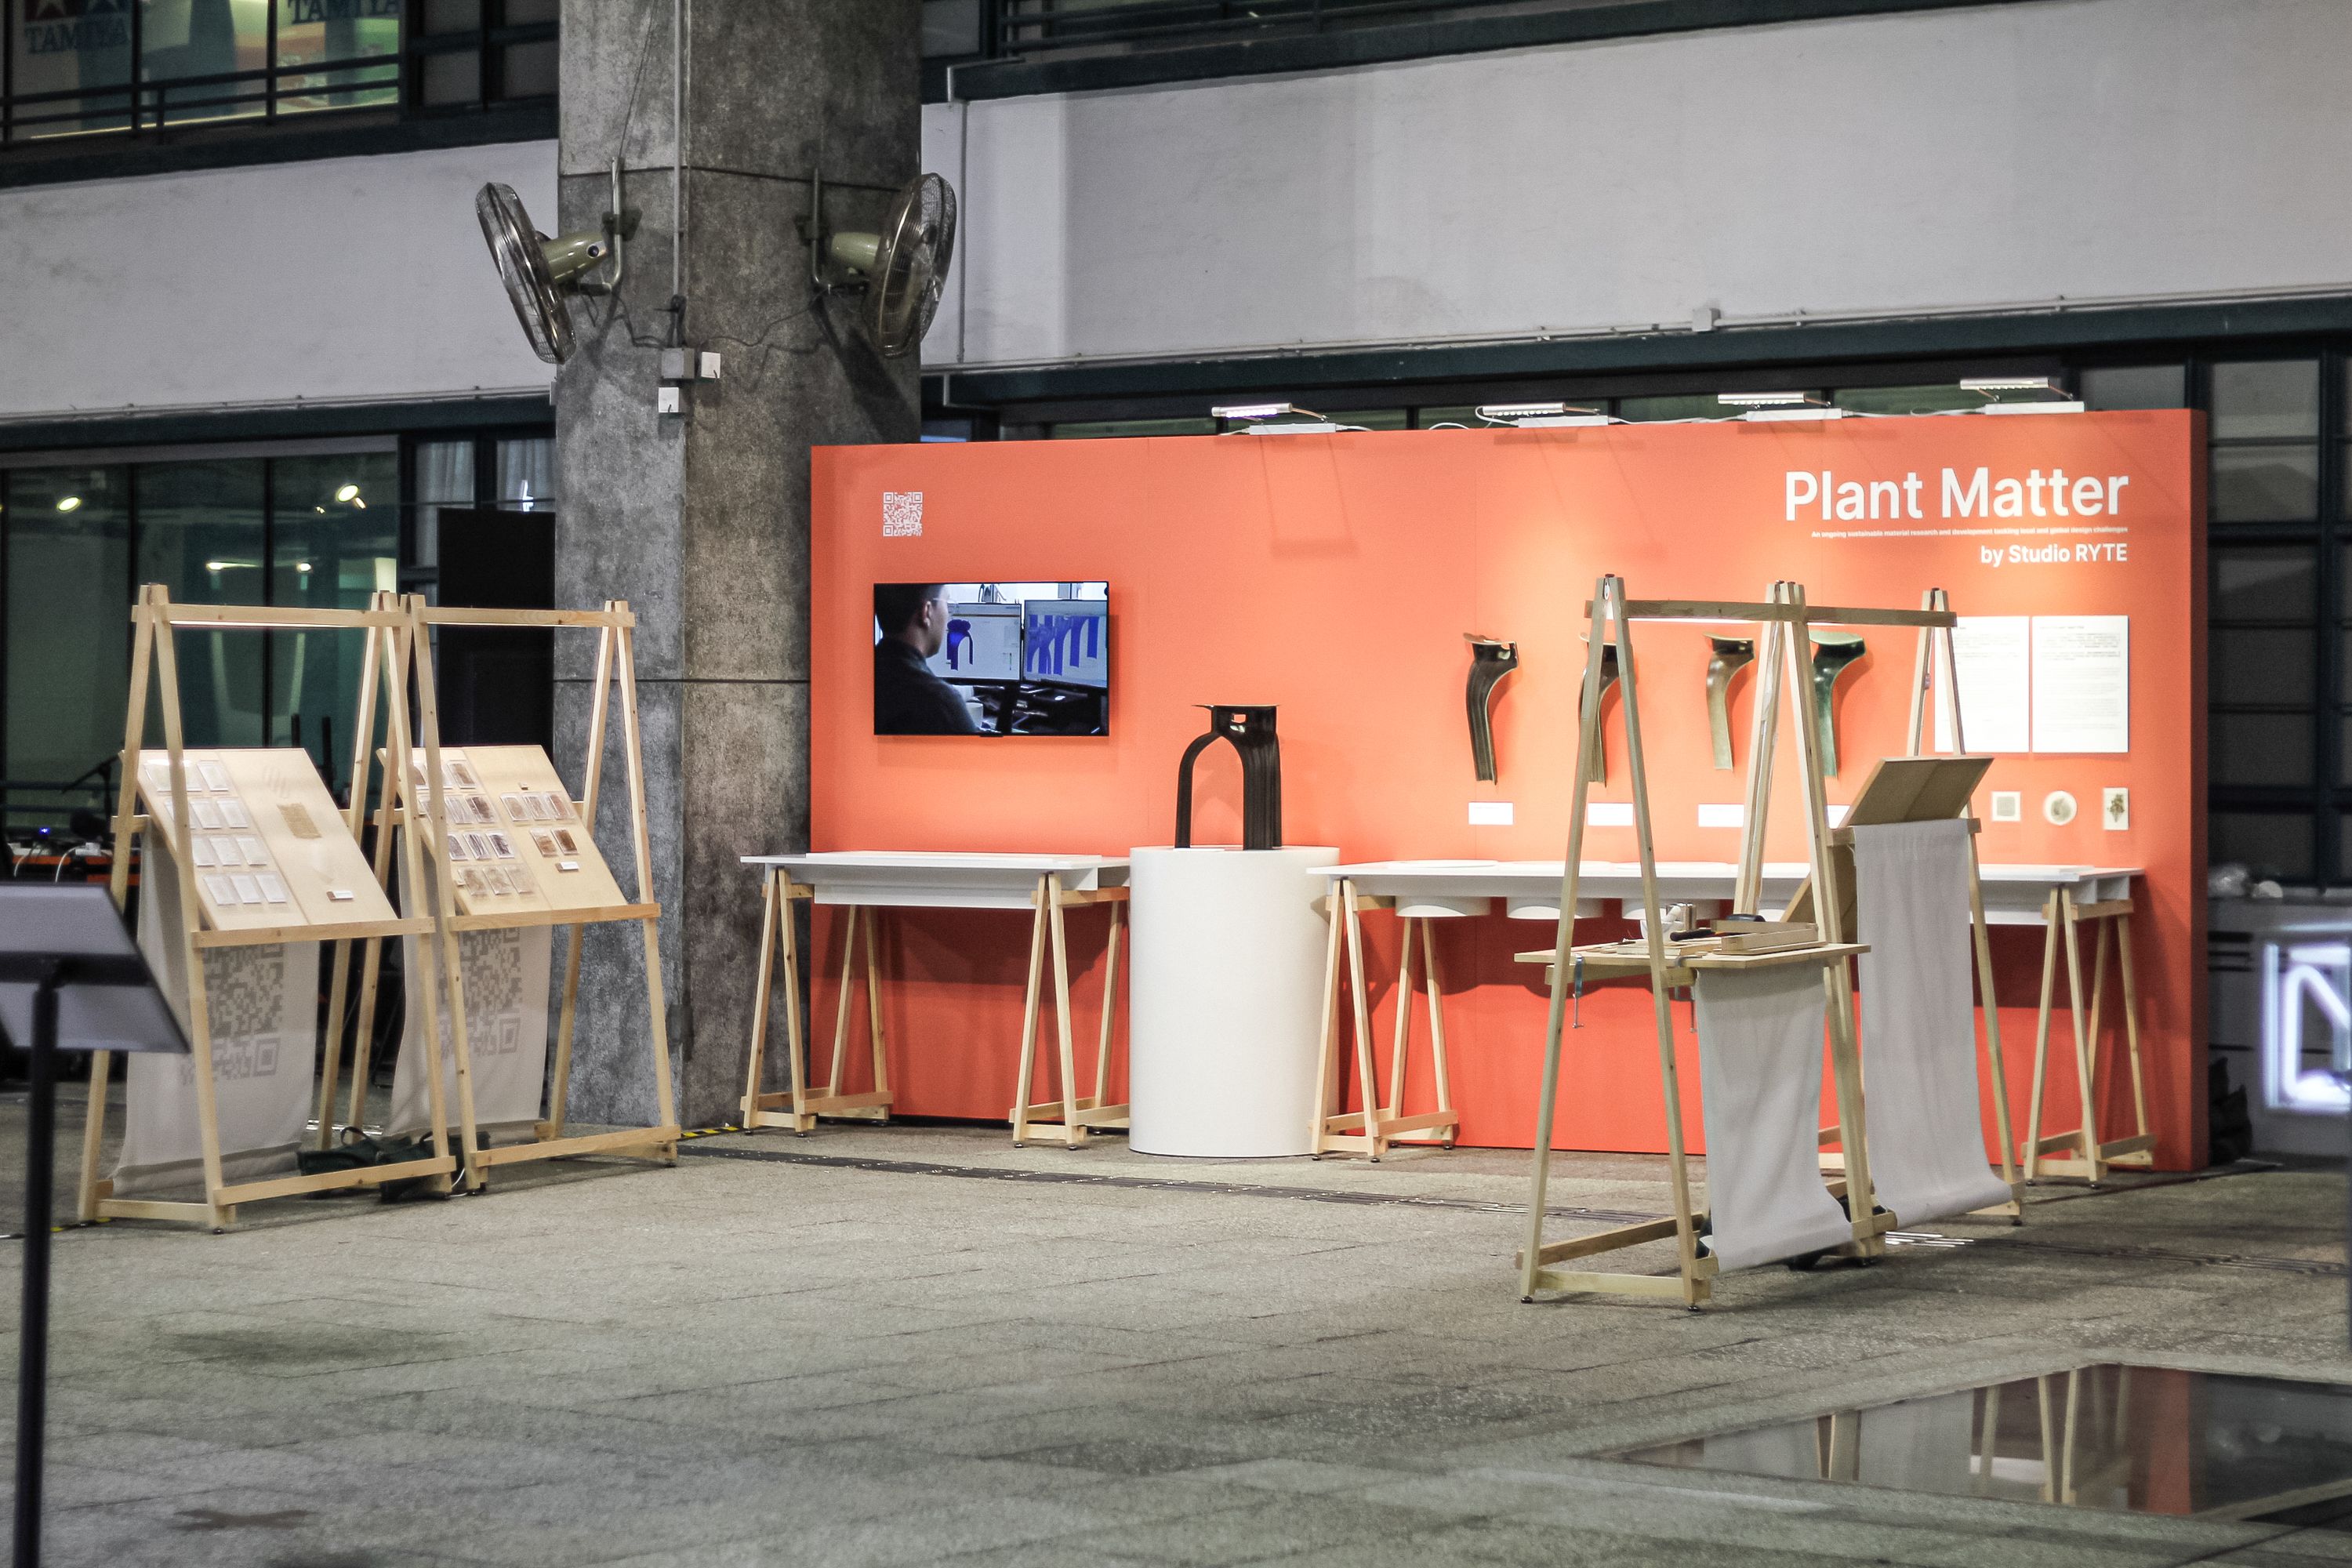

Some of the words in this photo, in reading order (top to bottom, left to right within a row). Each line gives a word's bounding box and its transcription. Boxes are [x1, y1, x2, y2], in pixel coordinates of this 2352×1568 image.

[1785, 470, 1924, 521] Plant
[1941, 466, 2129, 518] Matter
[1951, 528, 1993, 536] development
[2049, 527, 2070, 535] global
[2071, 526, 2093, 535] design
[1981, 546, 2004, 568] by
[2009, 543, 2071, 564] Studio
[2075, 543, 2129, 562] RYTE
